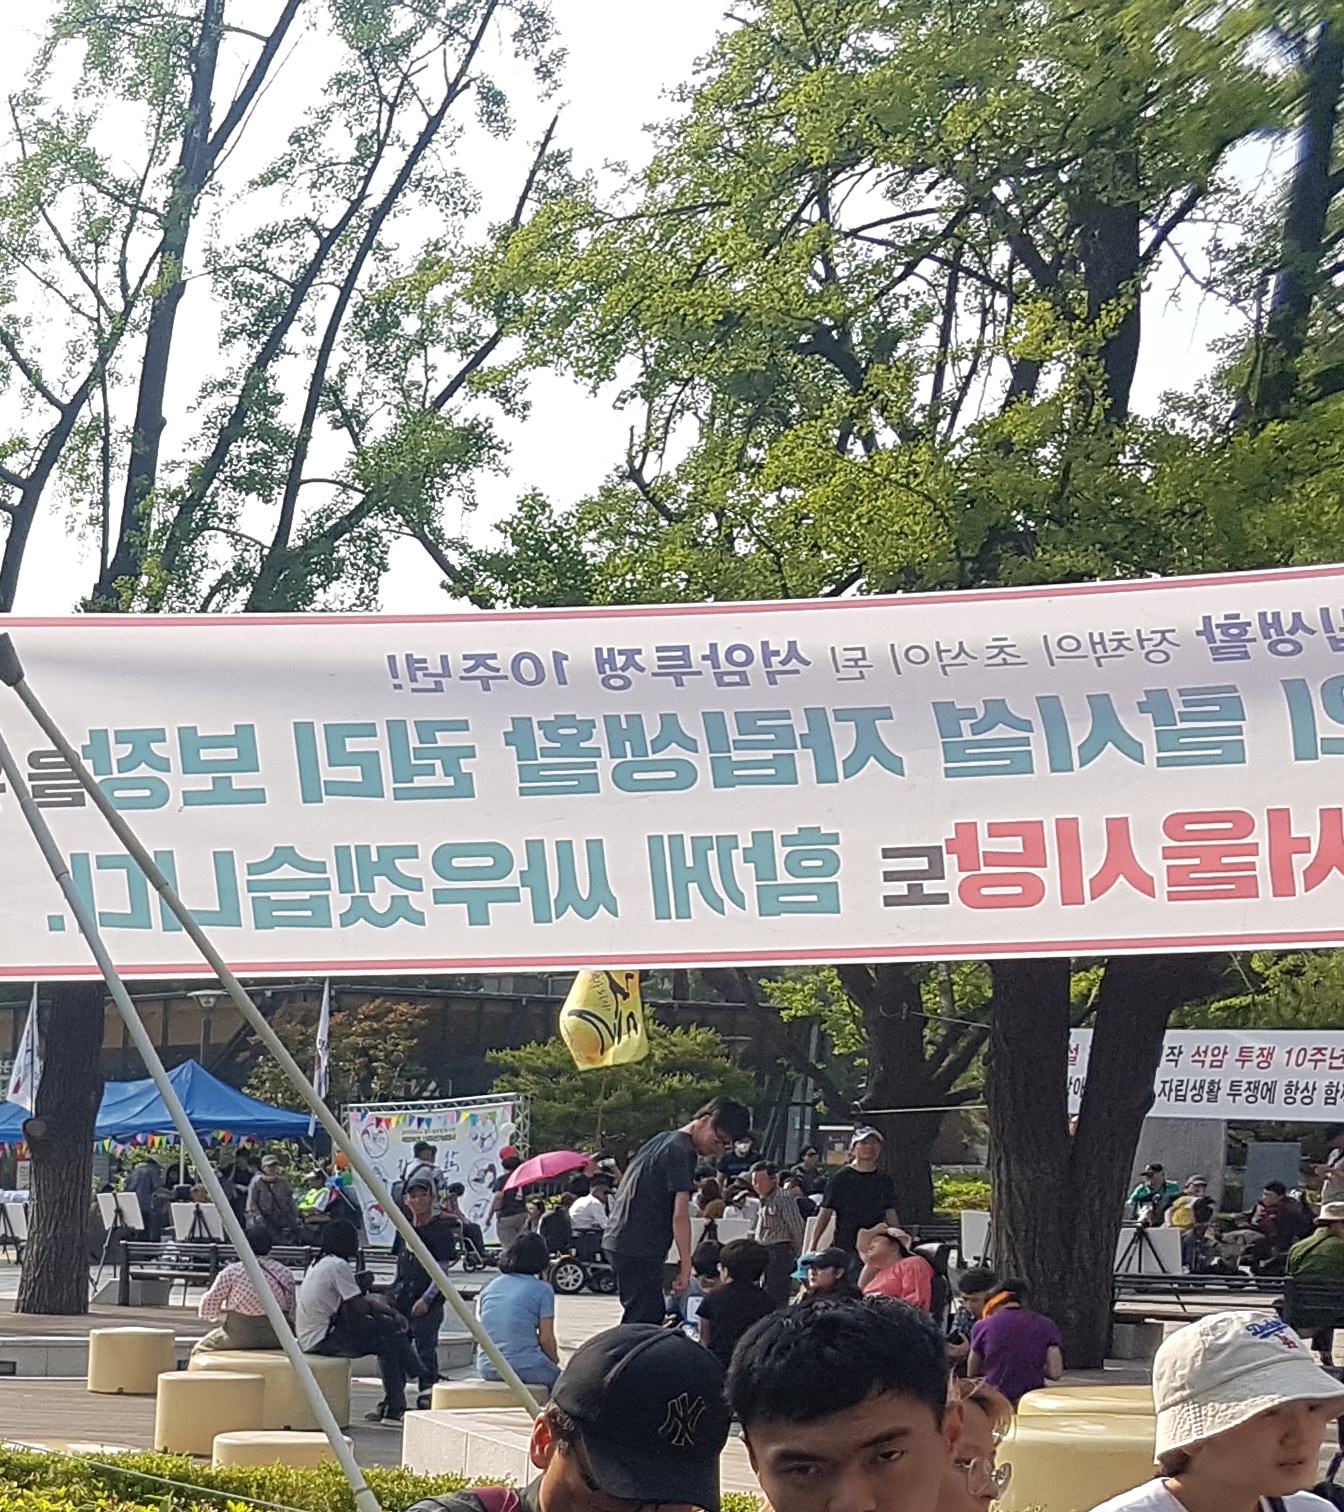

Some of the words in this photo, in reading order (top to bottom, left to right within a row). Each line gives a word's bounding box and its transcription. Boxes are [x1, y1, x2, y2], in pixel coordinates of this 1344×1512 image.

[1190, 1045, 1229, 1069] 석암
[1235, 1045, 1276, 1070] 투쟁
[1157, 1078, 1222, 1104] 자립생활
[1226, 1079, 1278, 1105] 투쟁에
[1283, 1080, 1318, 1106] 항상
[1324, 1081, 1344, 1107] 함
